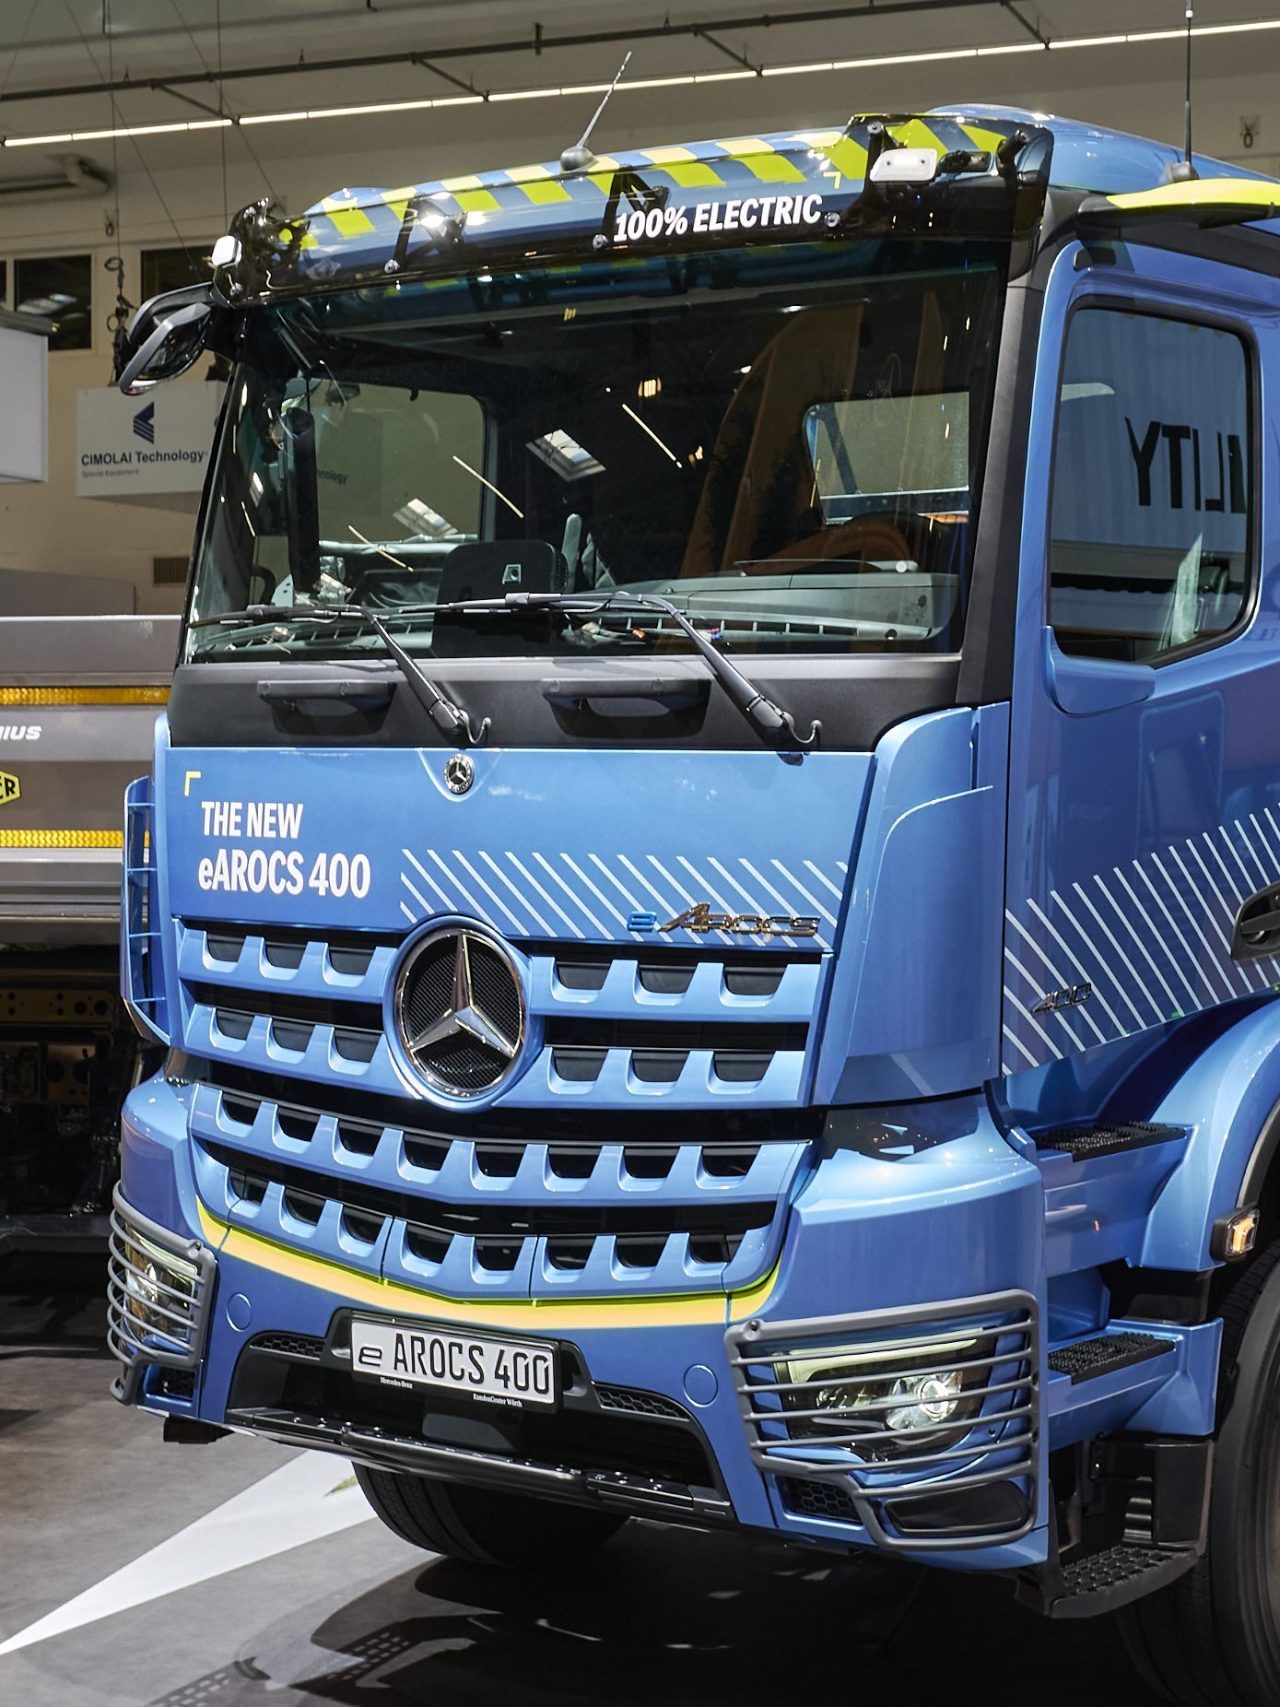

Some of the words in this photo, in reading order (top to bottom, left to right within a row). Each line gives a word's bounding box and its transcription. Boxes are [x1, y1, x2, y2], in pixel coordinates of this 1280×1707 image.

[614, 206, 688, 242] 100%
[693, 194, 823, 233] ELECTRIC
[81, 452, 132, 467] CIMOLAI
[135, 449, 205, 463] Technology
[201, 801, 243, 837] THE
[246, 802, 304, 839] NEW
[198, 848, 304, 895] eAROCS
[308, 852, 371, 899] 400
[393, 1332, 485, 1385] AROCS
[494, 1347, 550, 1395] 400
